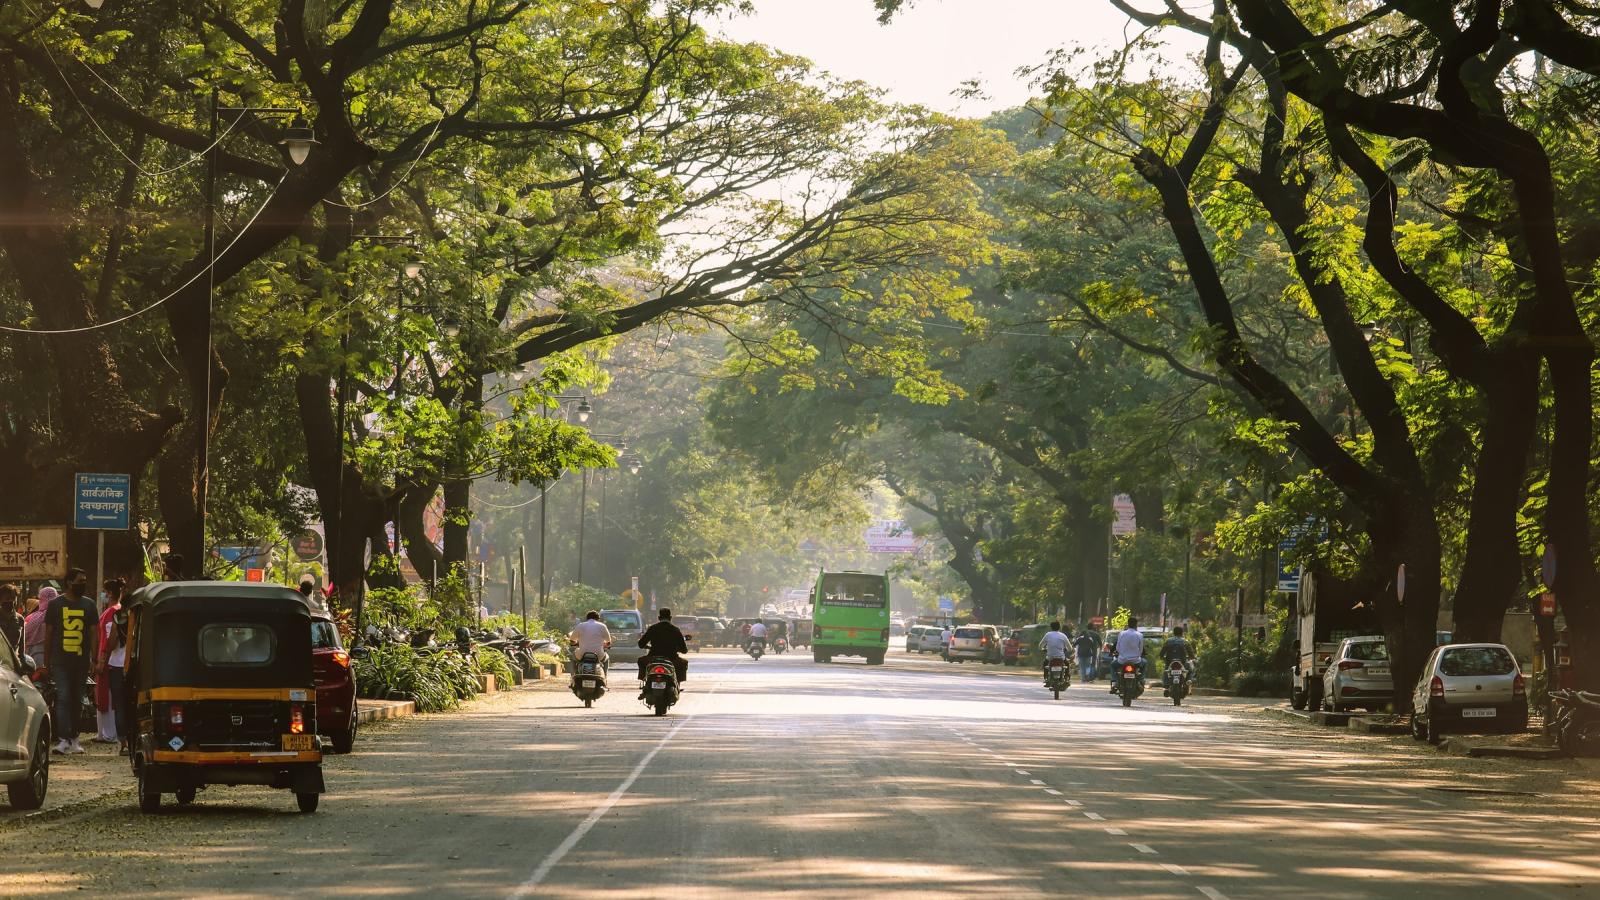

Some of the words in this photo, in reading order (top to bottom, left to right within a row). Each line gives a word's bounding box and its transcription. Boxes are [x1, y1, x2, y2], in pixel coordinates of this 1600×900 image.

[82, 487, 124, 498] सार्वजनिक
[80, 502, 125, 514] स्वच्छतागृह
[0, 532, 32, 547] द्यान
[1, 547, 59, 569] कार्यालय
[63, 607, 84, 656] JUST
